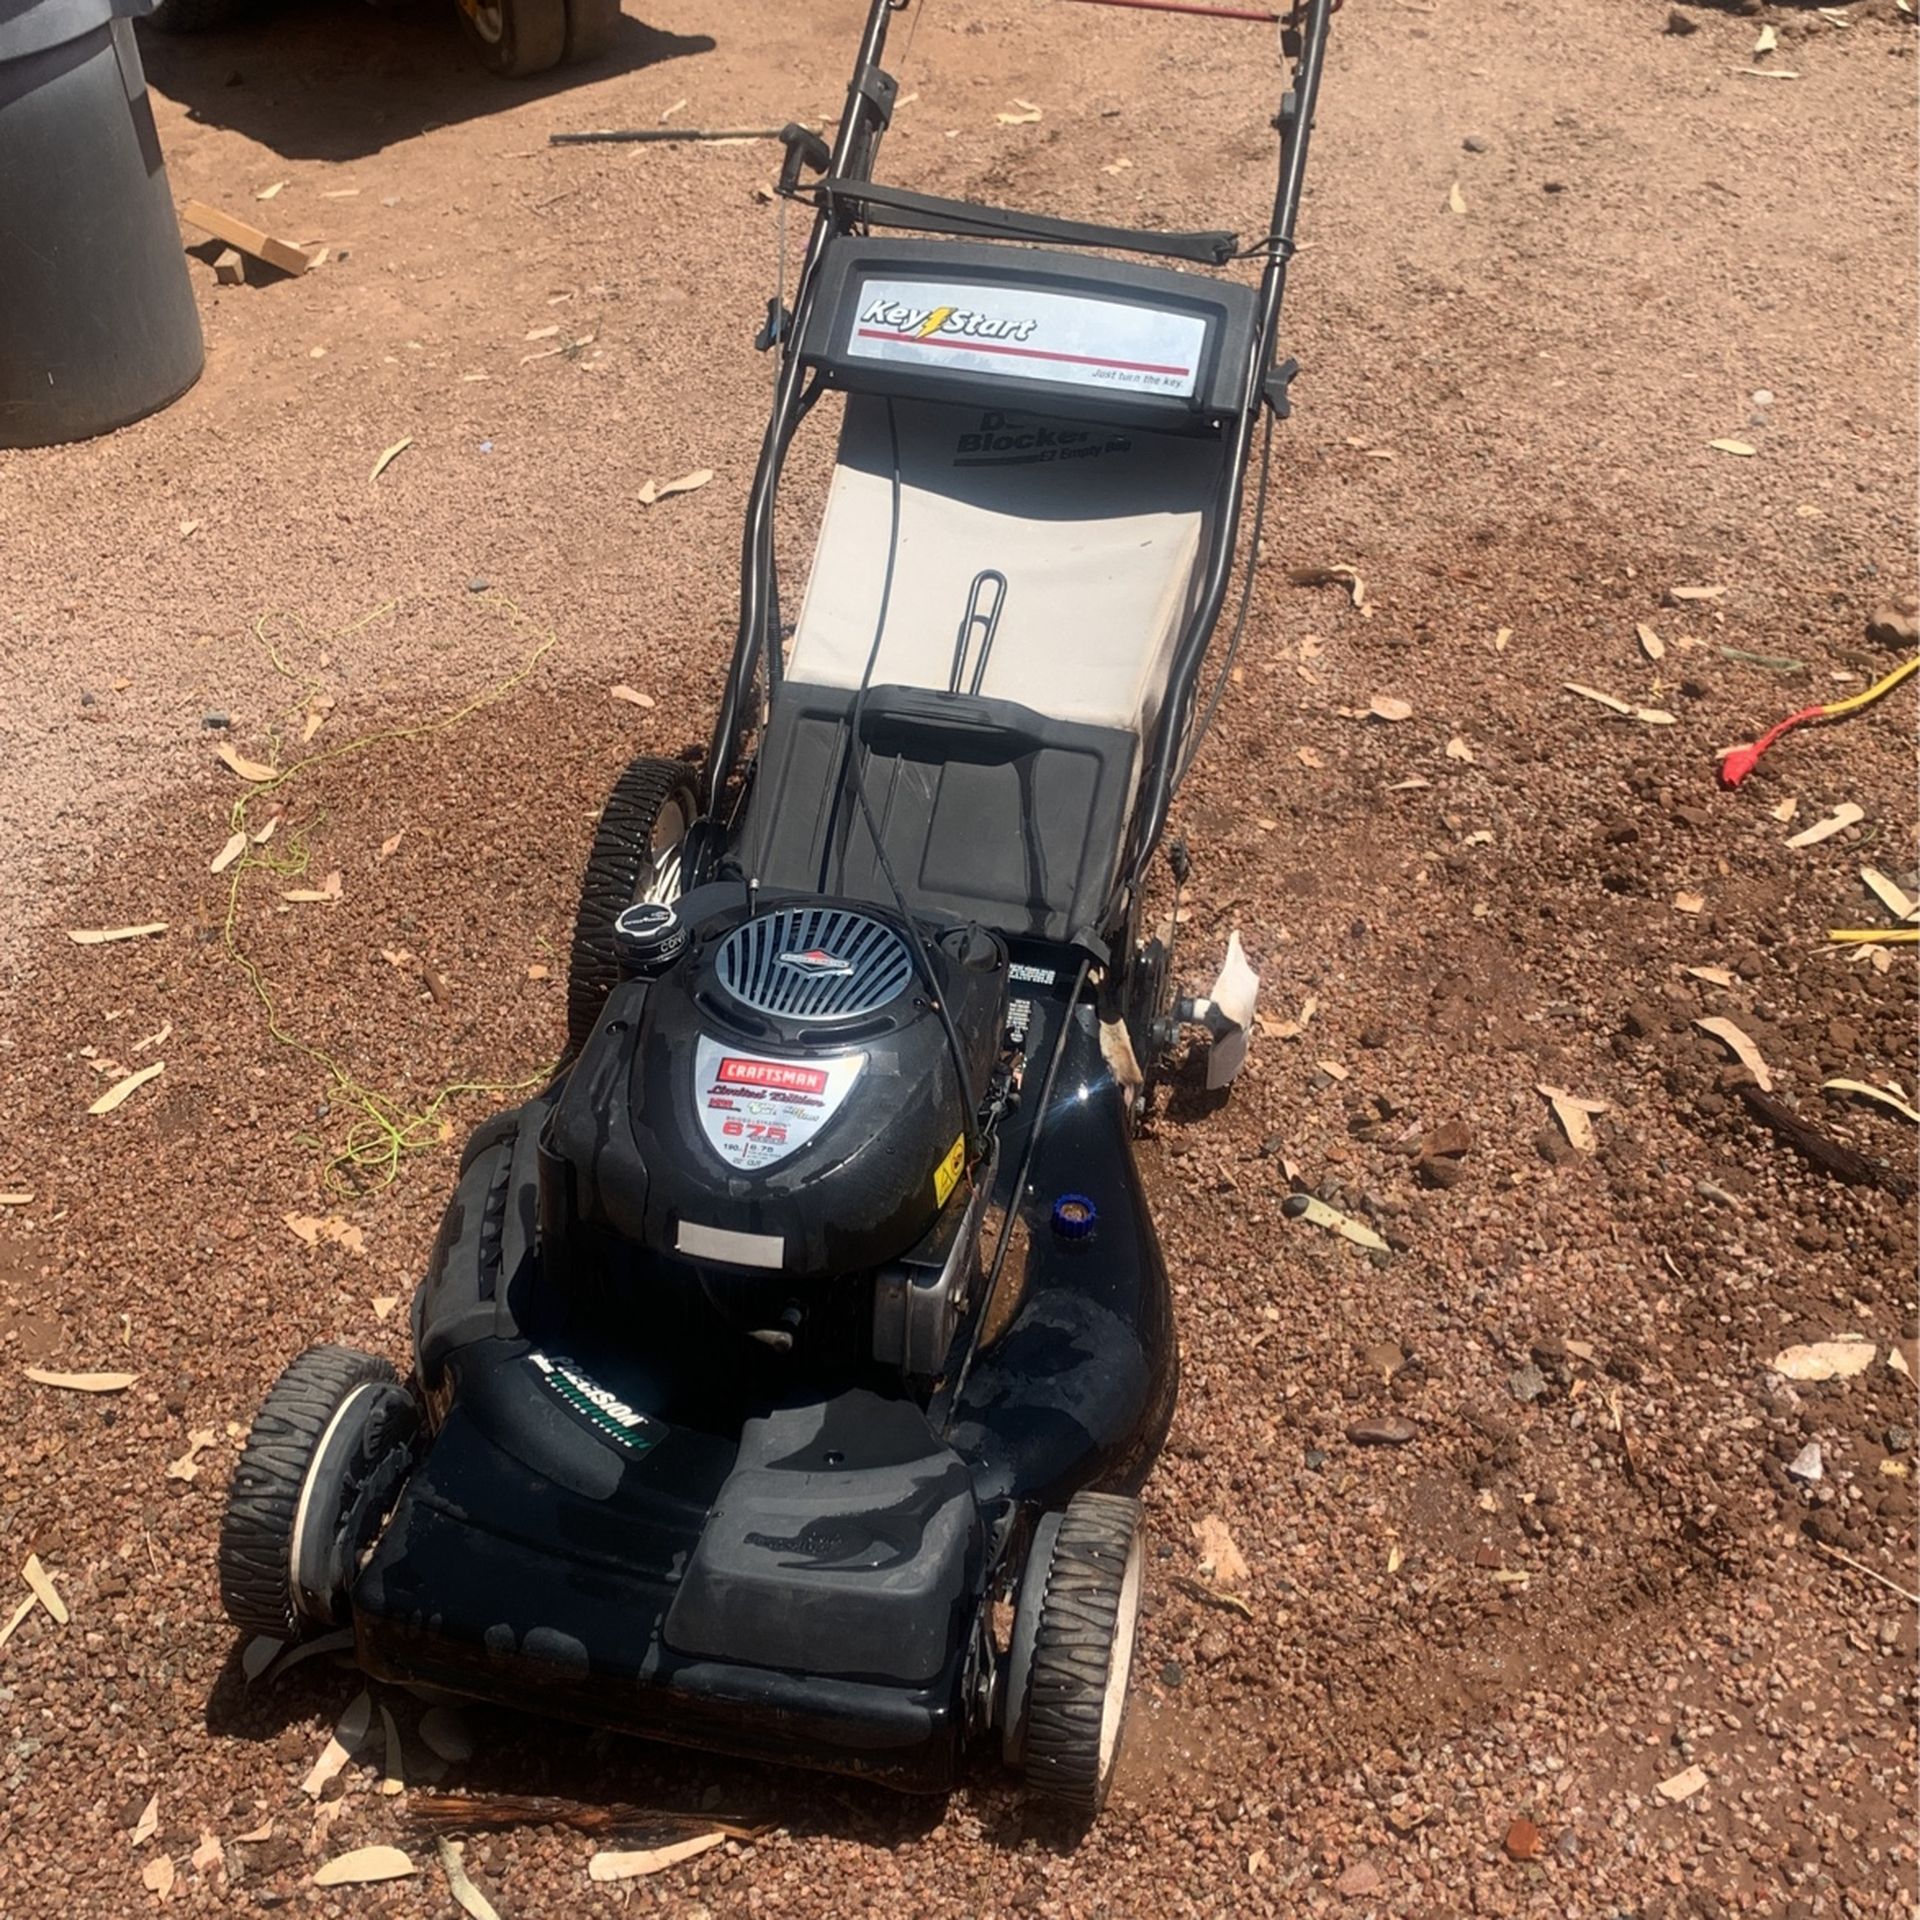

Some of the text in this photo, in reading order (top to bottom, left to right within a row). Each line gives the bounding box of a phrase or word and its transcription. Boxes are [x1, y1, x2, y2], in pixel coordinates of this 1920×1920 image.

[860, 299, 1038, 342] Key Start
[1143, 374, 1161, 385] the
[956, 427, 1089, 453] Blocker
[726, 1063, 819, 1087] CRAFTSMAN
